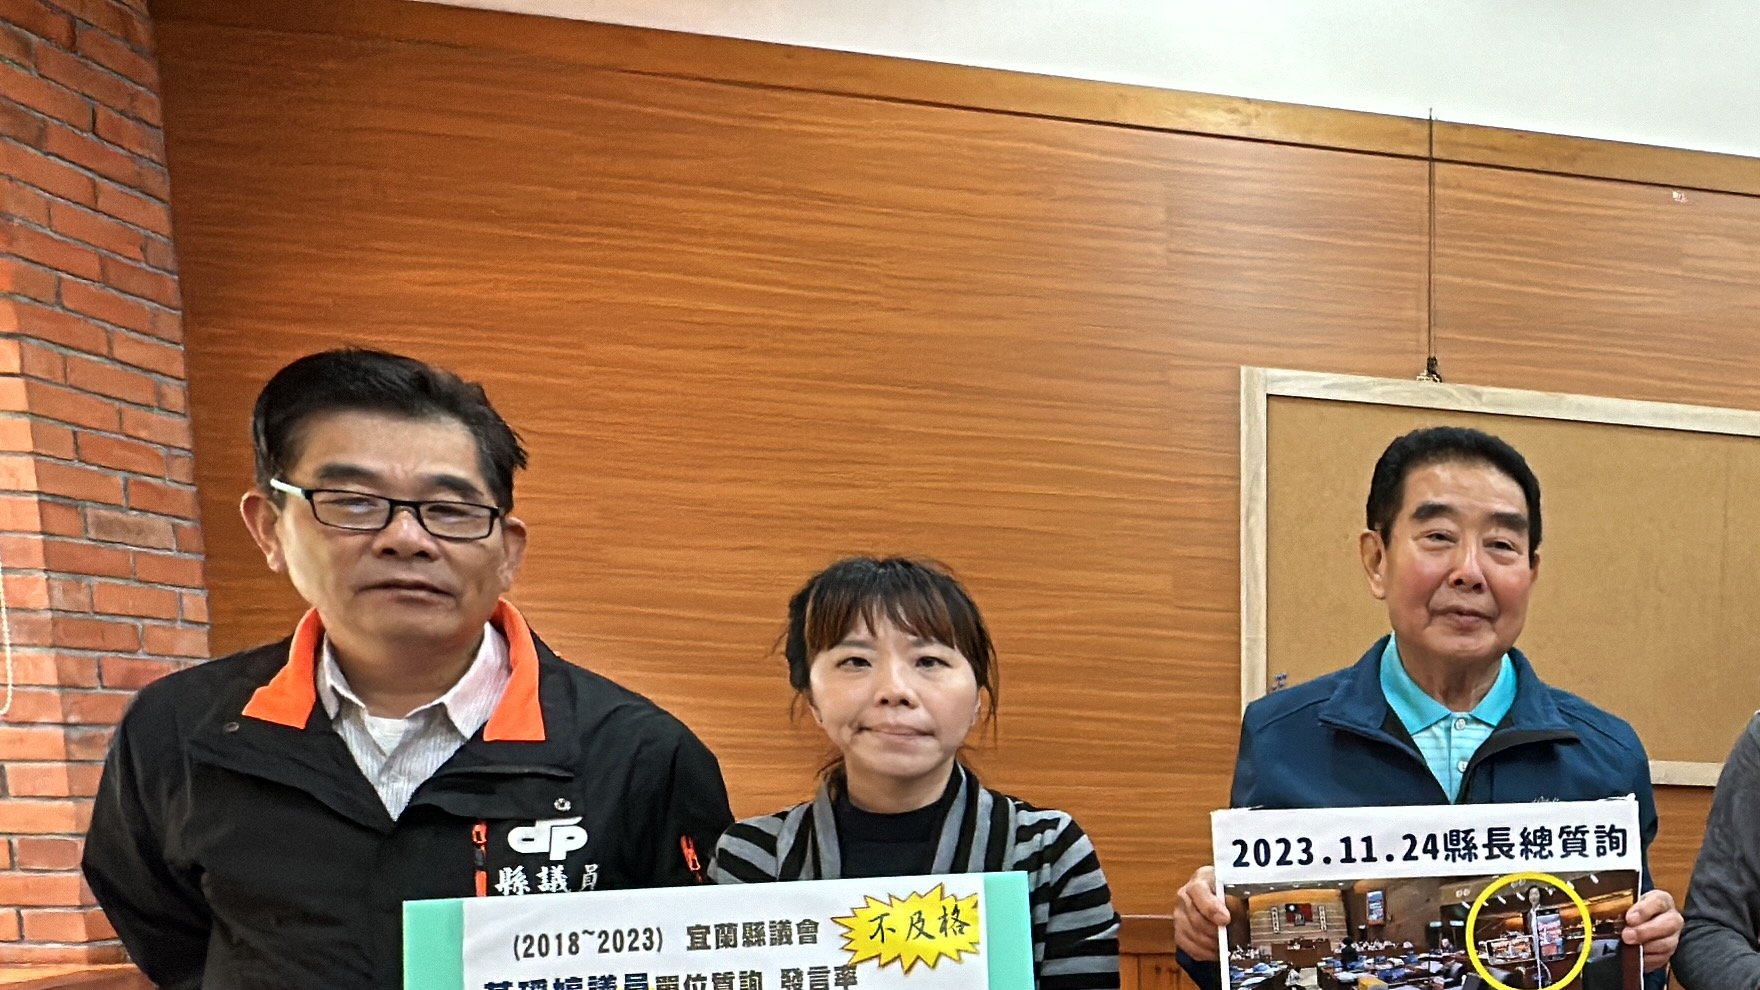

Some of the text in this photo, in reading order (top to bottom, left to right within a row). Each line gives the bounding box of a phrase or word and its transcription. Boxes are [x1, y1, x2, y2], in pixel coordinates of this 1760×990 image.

[1231, 824, 1629, 868] 2023.11.24縣長總質詢
[494, 864, 599, 896] 縣議員
[513, 918, 821, 960] (2018~2023) 宜蘭縣議會
[868, 904, 972, 944] 不及格
